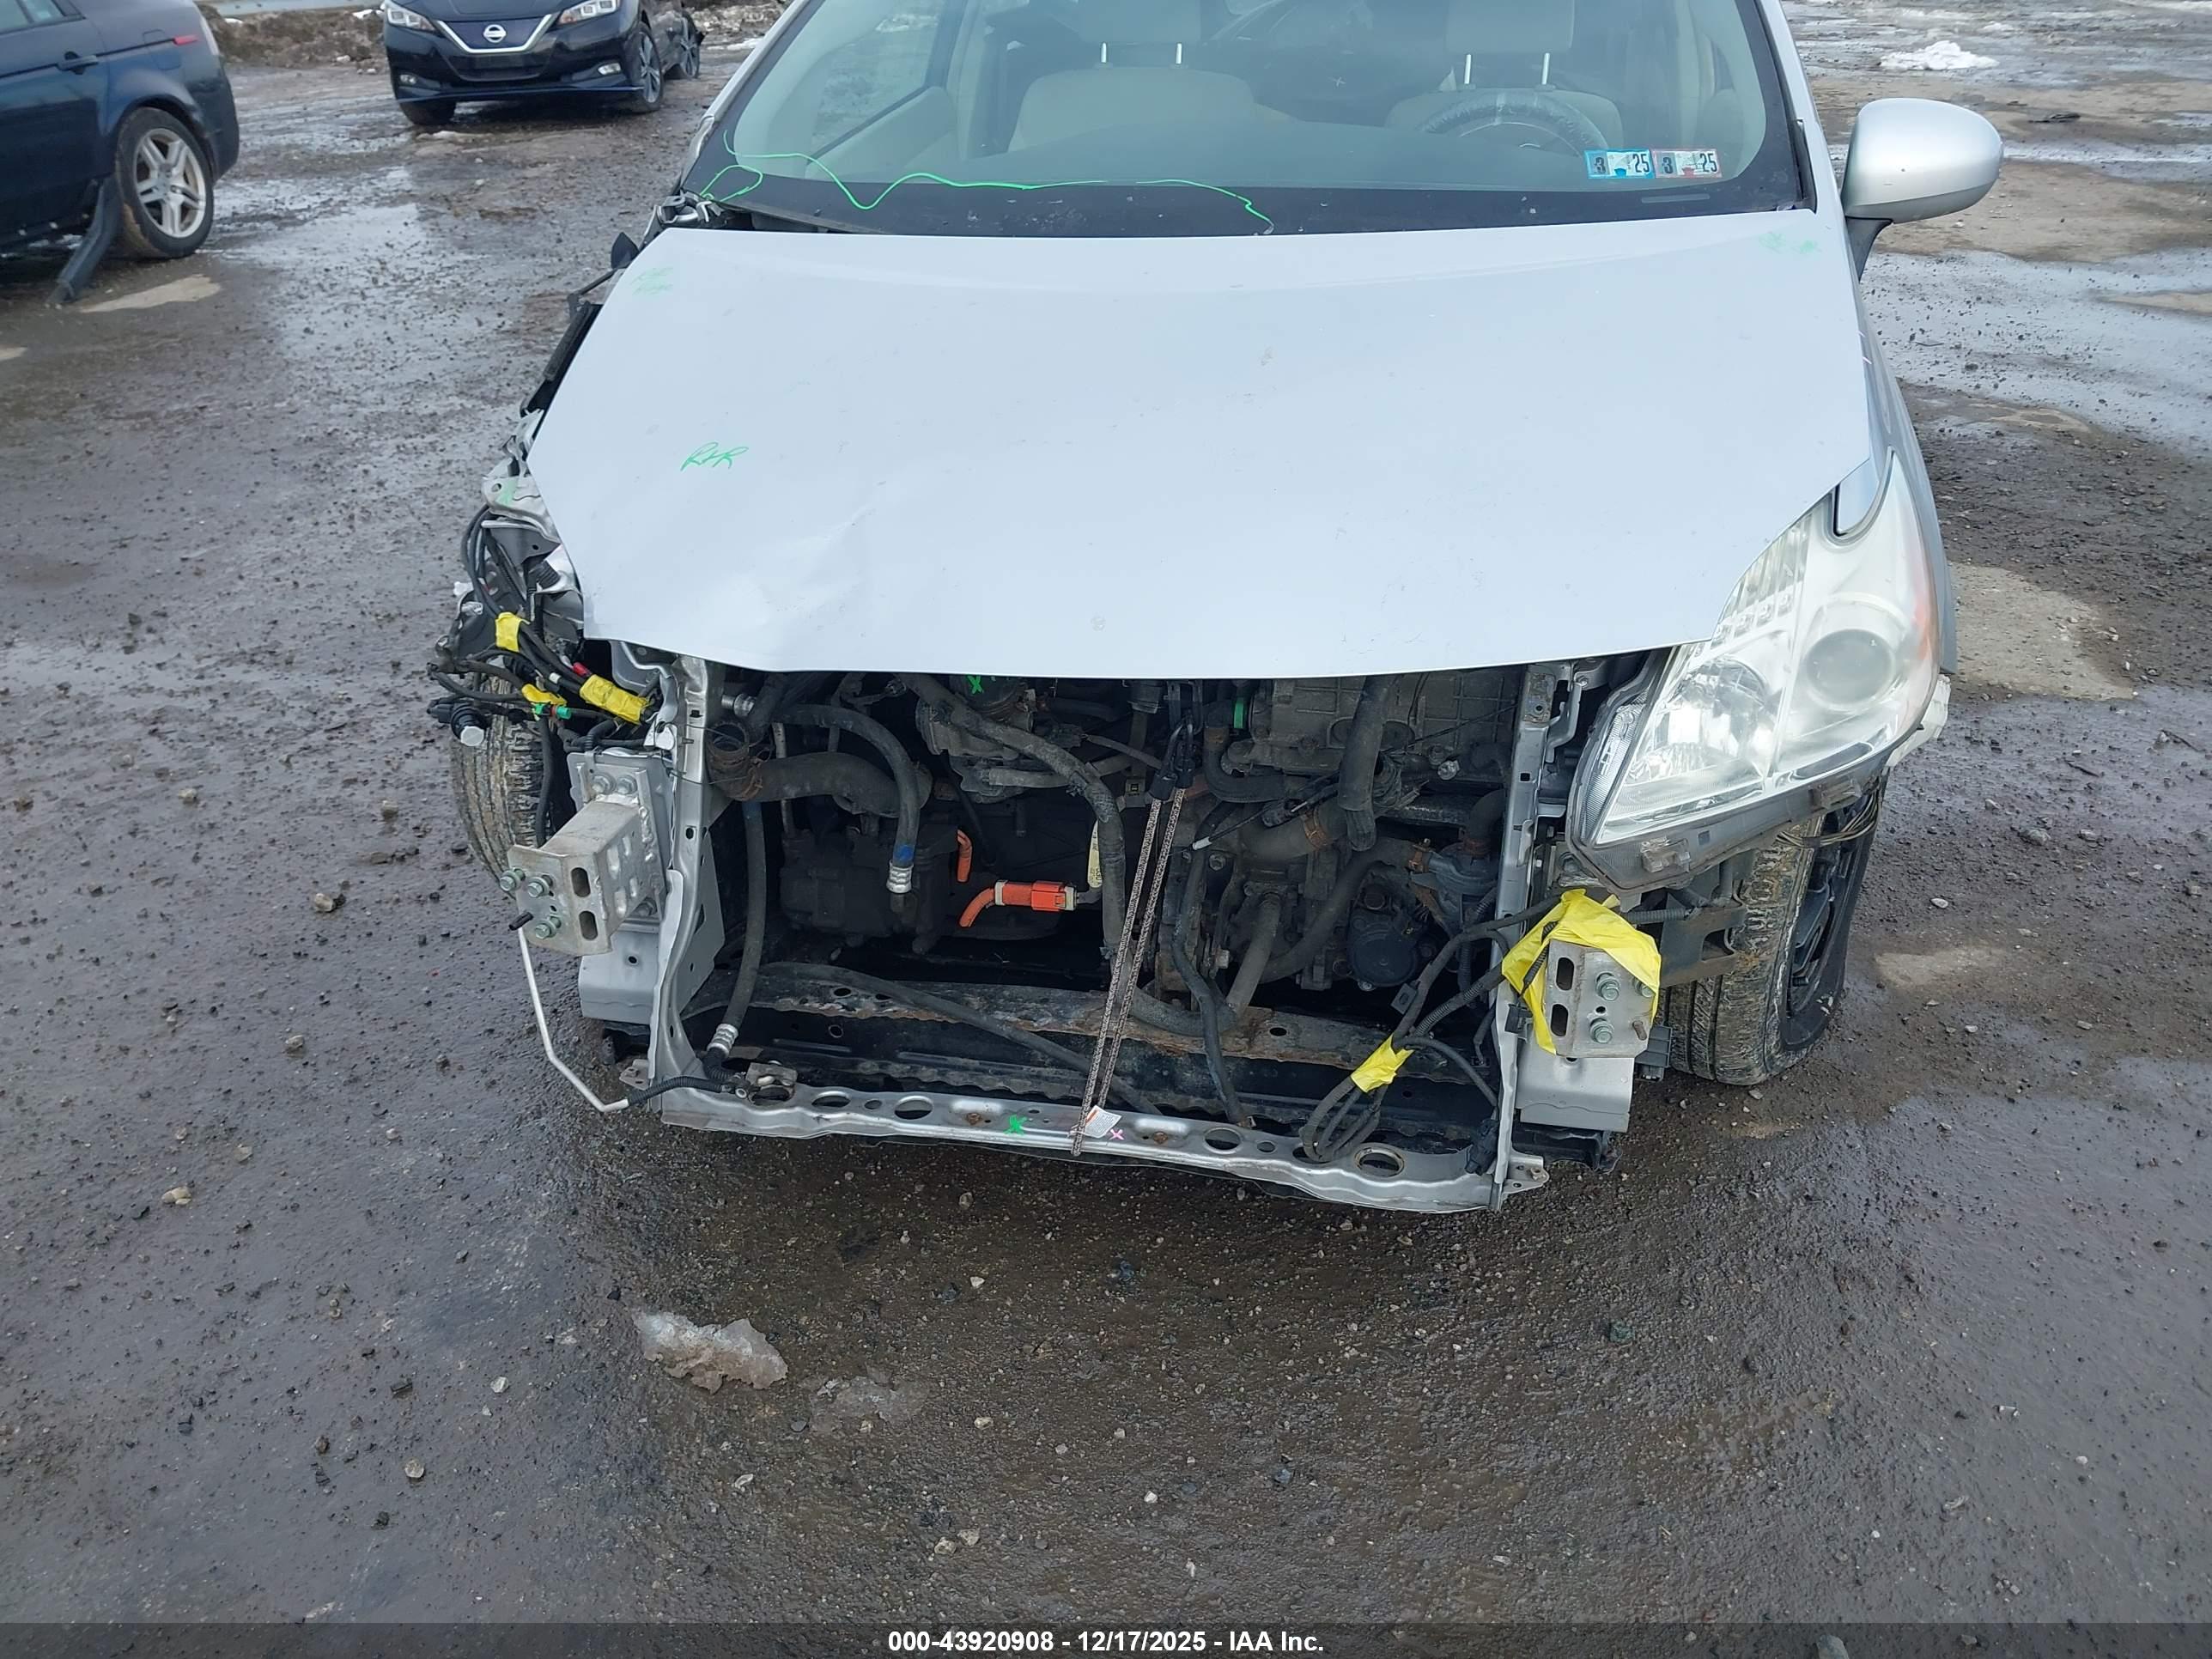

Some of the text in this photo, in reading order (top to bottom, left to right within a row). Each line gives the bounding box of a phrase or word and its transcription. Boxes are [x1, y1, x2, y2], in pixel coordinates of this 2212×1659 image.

[1595, 156, 1607, 174] 3
[1632, 153, 1650, 173] 25
[1662, 156, 1674, 174] 3
[1700, 152, 1718, 173] 25
